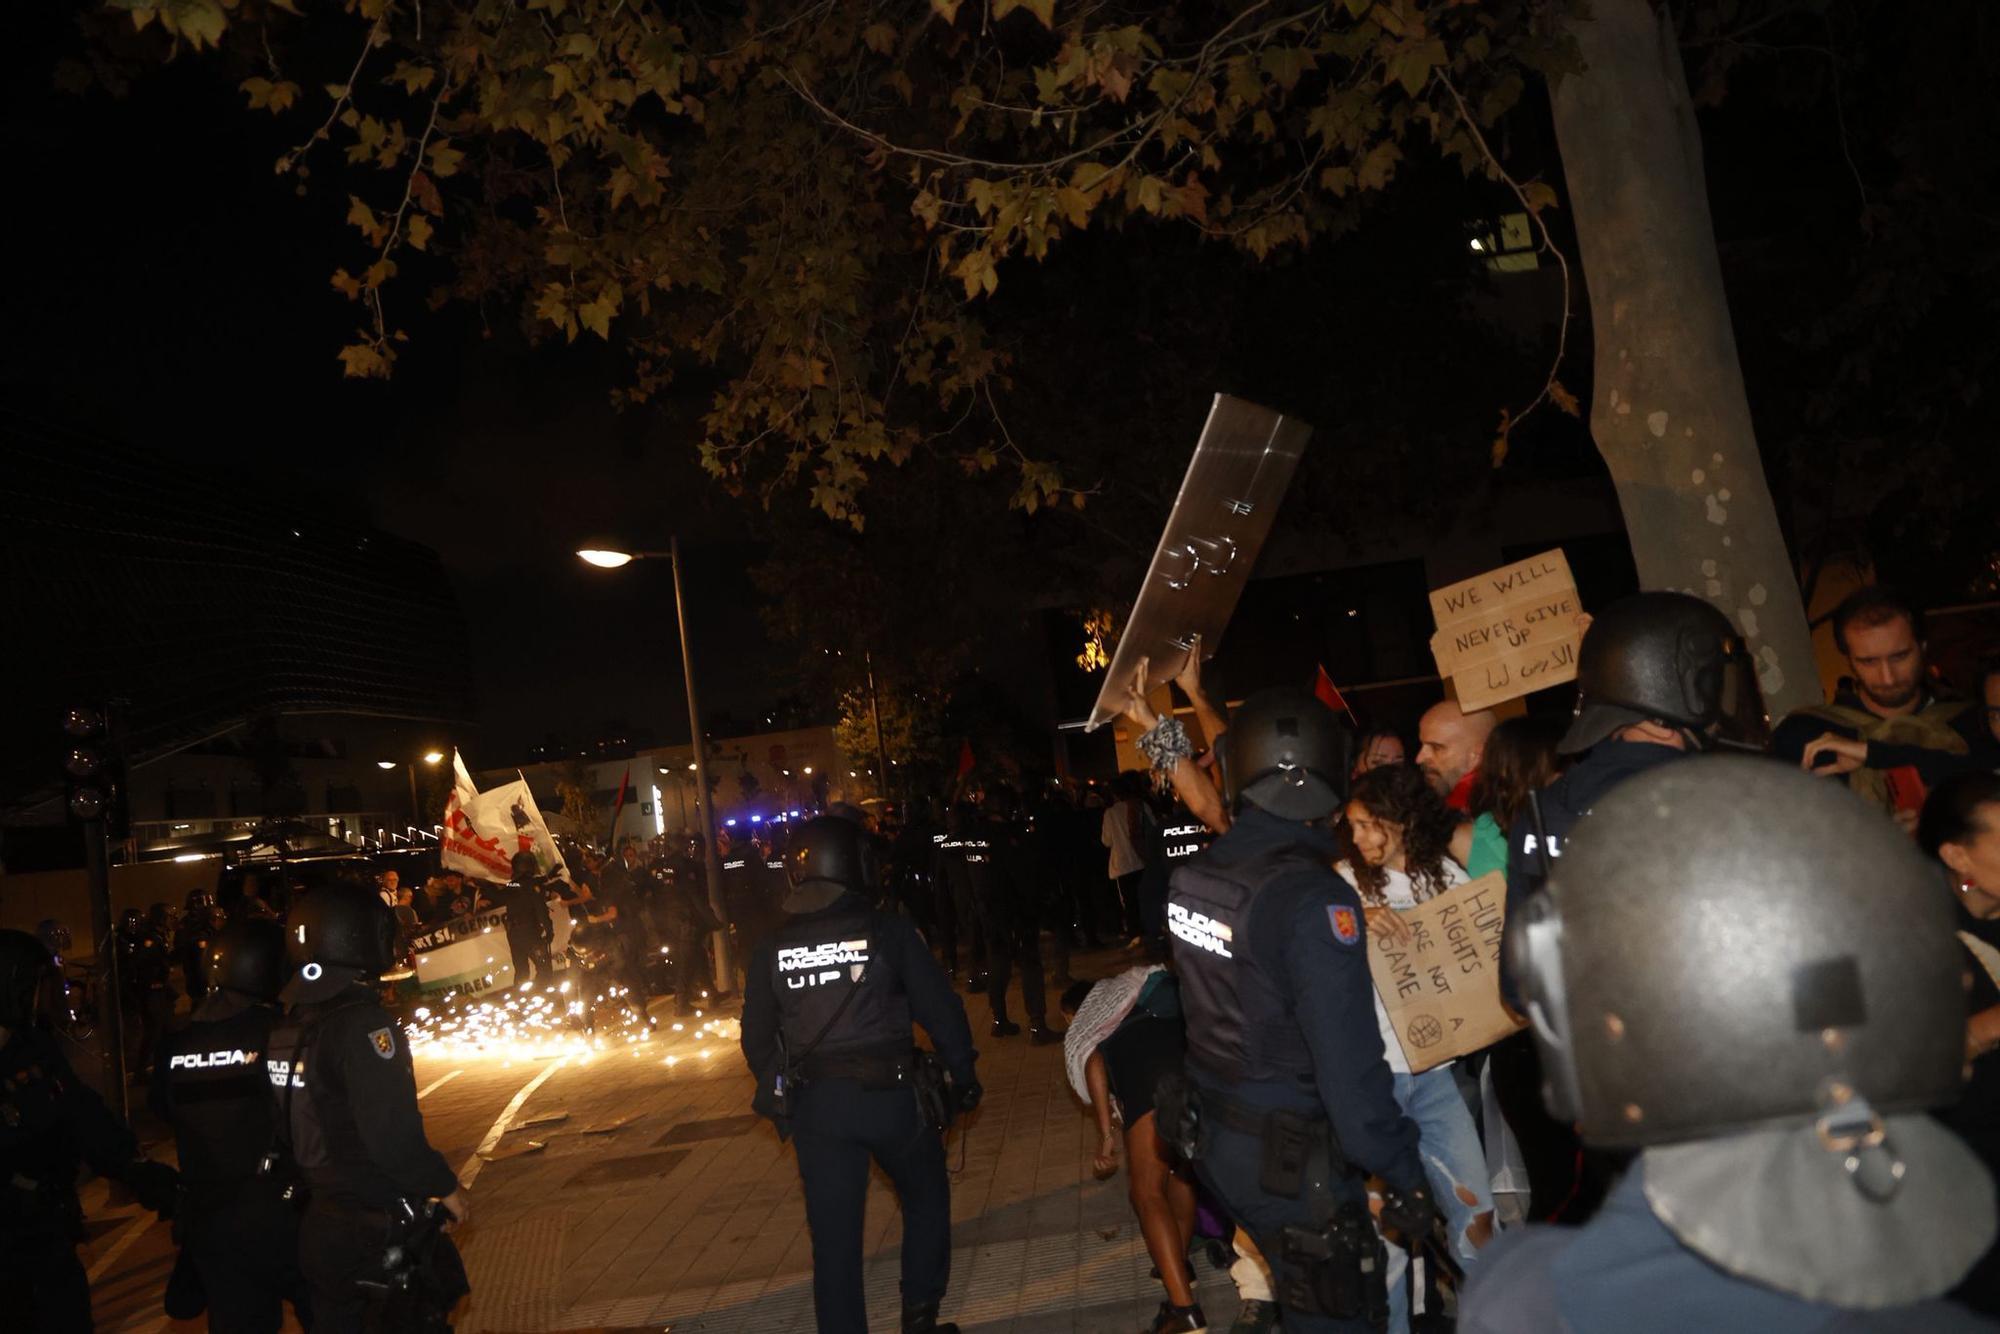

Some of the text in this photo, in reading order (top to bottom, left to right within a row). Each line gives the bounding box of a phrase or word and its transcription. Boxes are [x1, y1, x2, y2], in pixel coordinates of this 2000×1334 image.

[1444, 563, 1556, 613] WE WILL
[1455, 600, 1572, 652] NEVER GIVE
[1508, 628, 1531, 647] UP
[1163, 824, 1207, 837] POLICIA
[459, 912, 508, 936] GENOC
[1168, 902, 1217, 937] POLICIA
[1464, 889, 1503, 962] HUMA
[778, 941, 849, 961] POLICIA
[1437, 904, 1482, 974] RIGHTS
[779, 951, 869, 972] NACIONAL
[1409, 920, 1464, 1031] ARE NOT A
[170, 1049, 245, 1070] POLICIA
